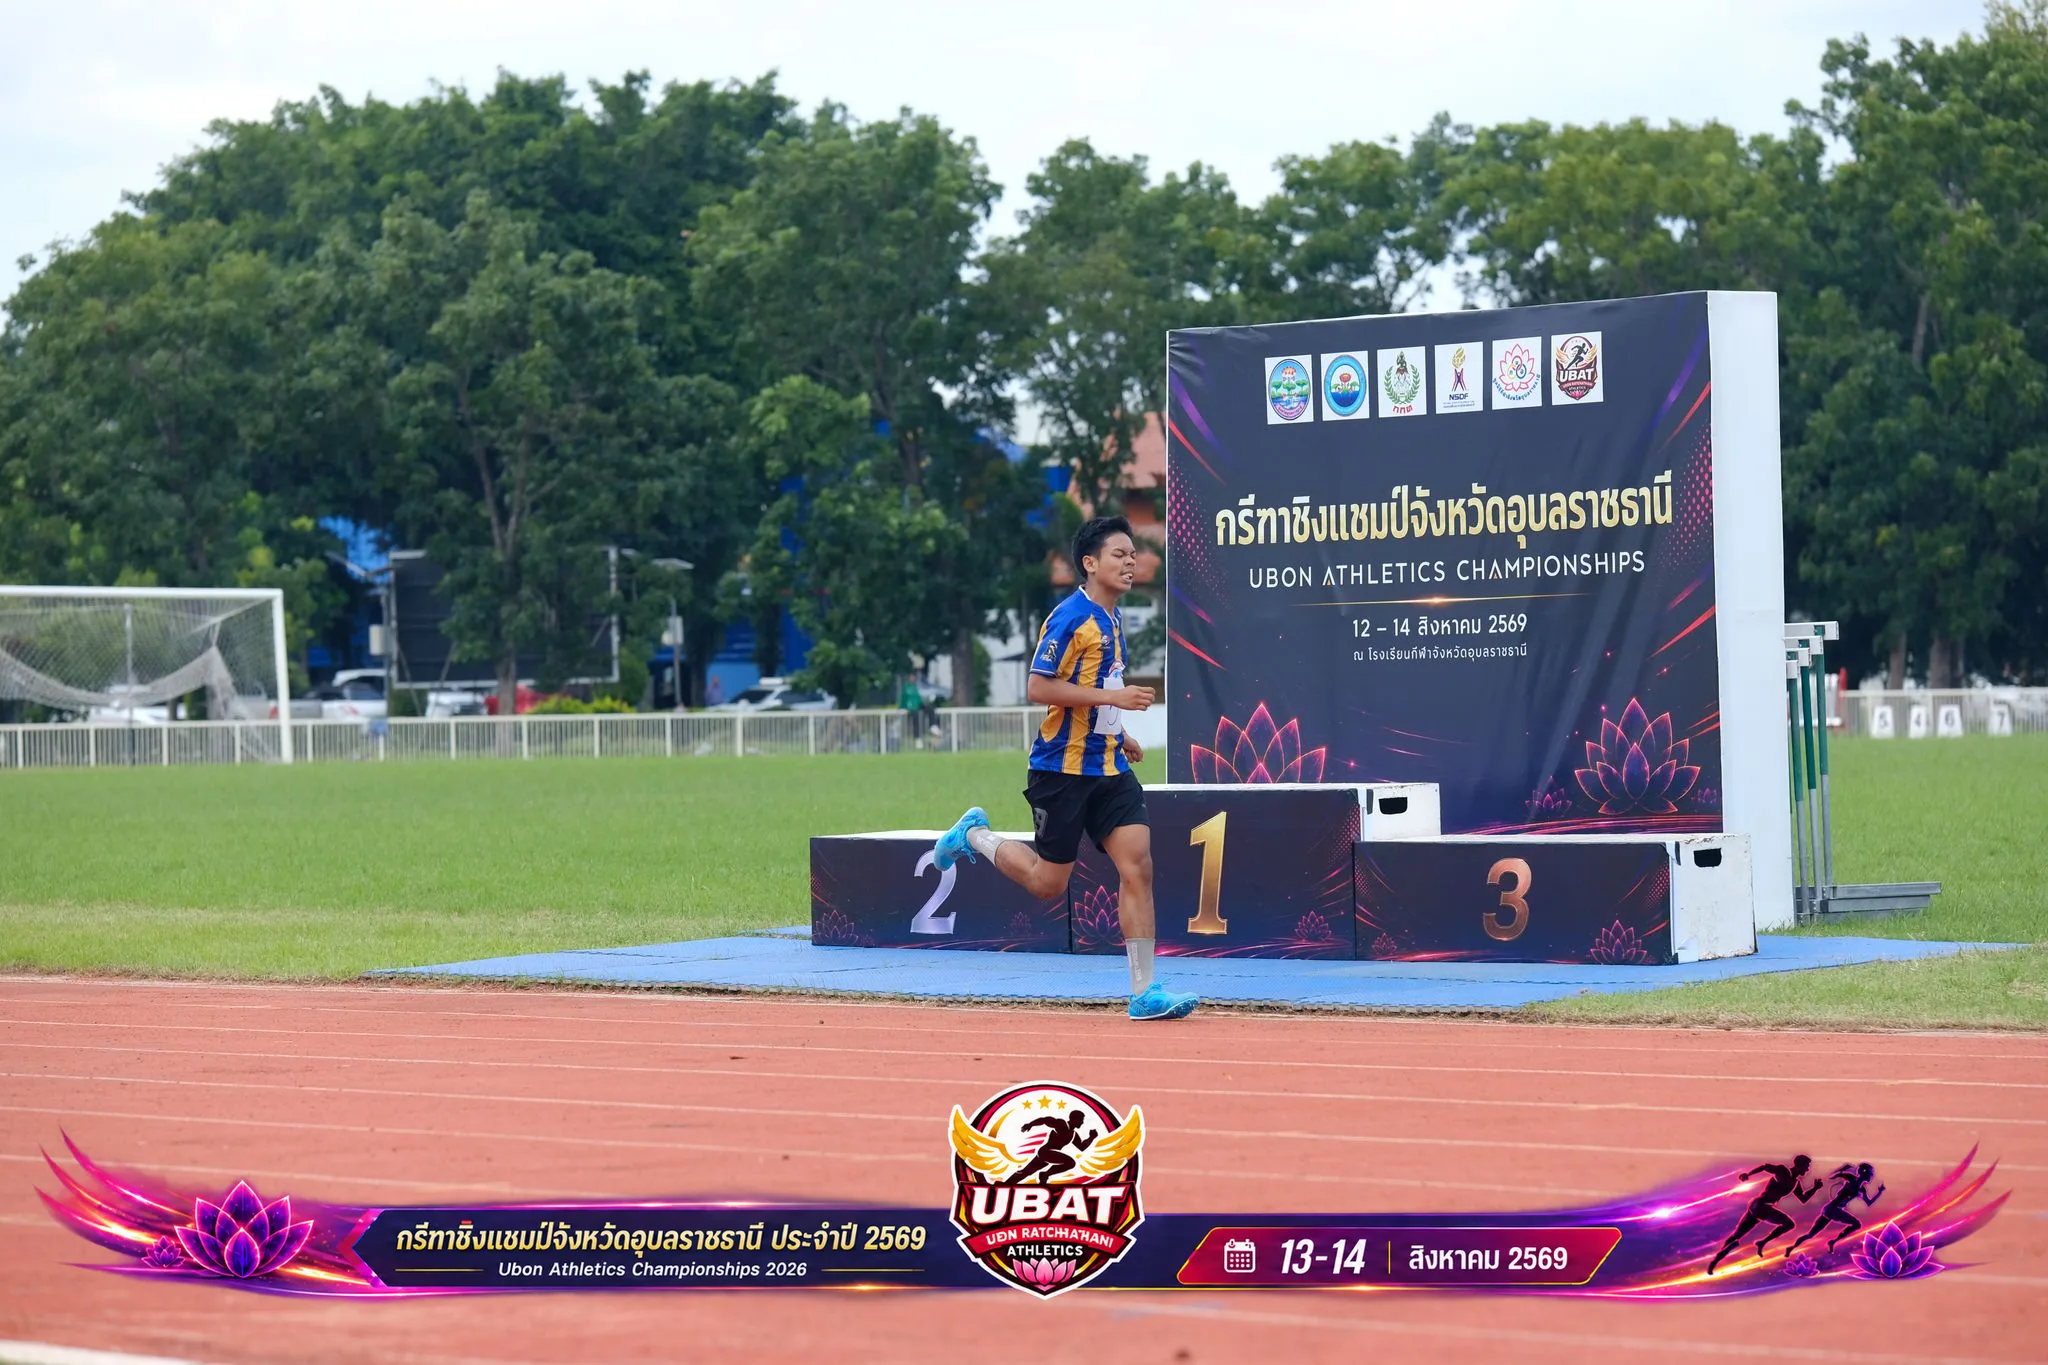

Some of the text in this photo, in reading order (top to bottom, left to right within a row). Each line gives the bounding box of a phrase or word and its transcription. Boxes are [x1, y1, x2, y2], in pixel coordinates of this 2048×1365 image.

[1560, 368, 1594, 382] UBAT
[1215, 469, 1673, 548] กรีฑาชิงแชมป์จังหวัดอุบลราชธานี
[1249, 550, 1645, 588] UBON ATHLETICS CHAMPIONSHIPS
[1352, 619, 1370, 637] 12
[1393, 618, 1410, 636] 14
[1418, 616, 1481, 636] สิงหาคม
[1488, 613, 1528, 633] 2569
[1353, 643, 1528, 662] ณ โรงเรียนกีฬาจังหวัดอุบลราชธานี
[1879, 710, 1889, 728] 5
[1944, 710, 1955, 728] 6
[1997, 710, 2006, 729] 7
[1188, 811, 1229, 935] 1
[911, 849, 958, 935] 2
[1483, 858, 1533, 941] 3
